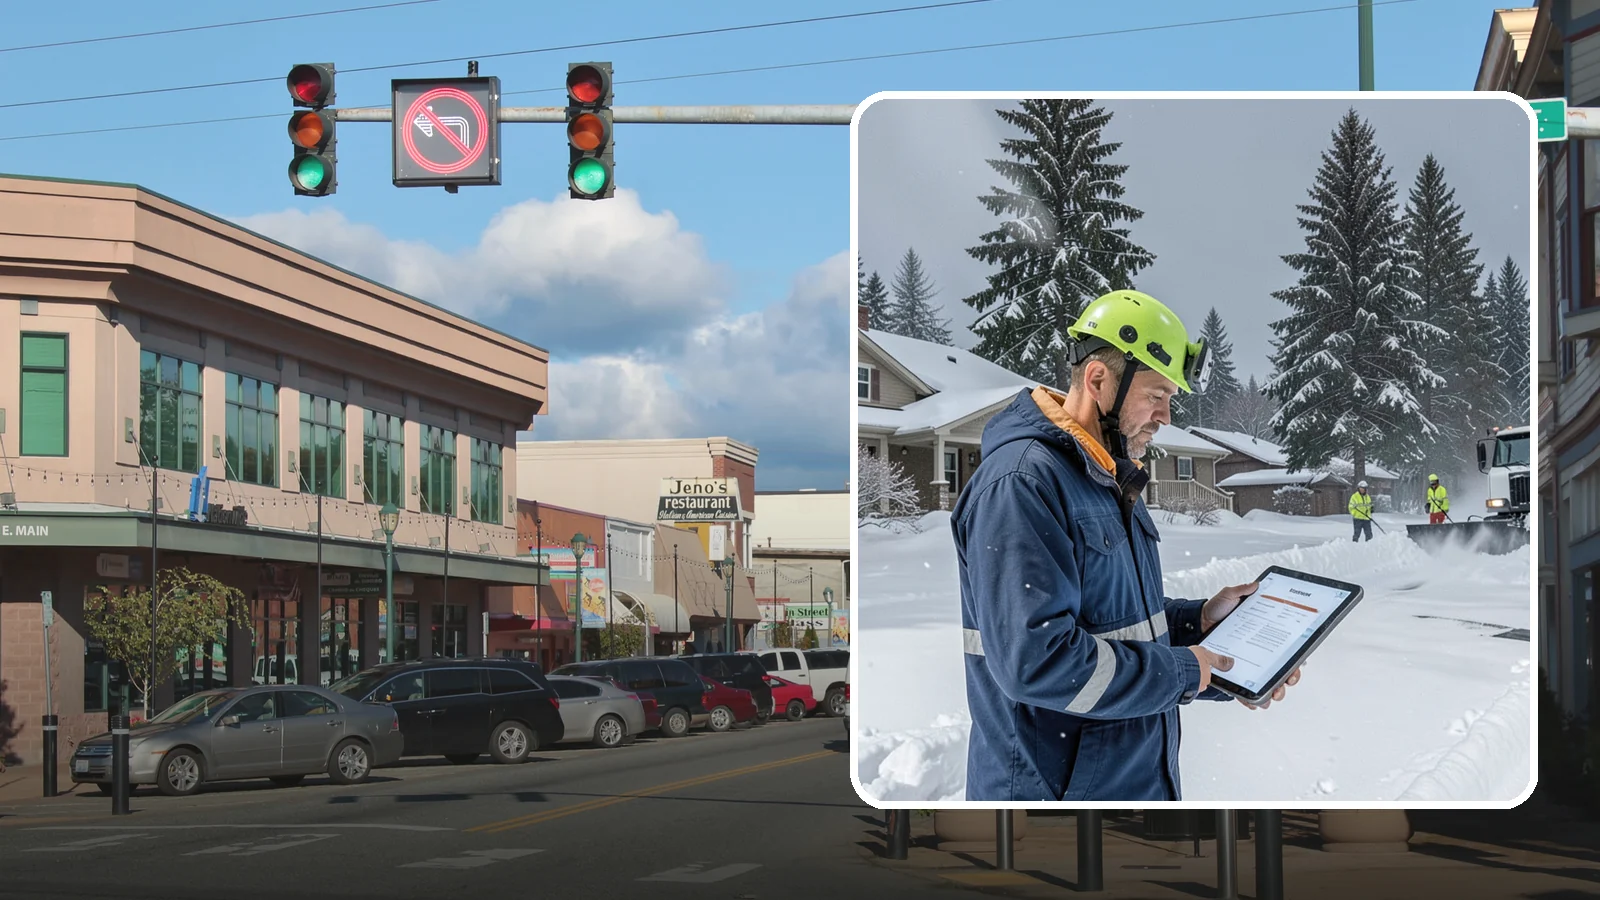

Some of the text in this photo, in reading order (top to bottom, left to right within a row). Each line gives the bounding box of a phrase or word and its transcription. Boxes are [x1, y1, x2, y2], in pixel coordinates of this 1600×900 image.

[669, 479, 728, 495] Jeno's
[665, 496, 731, 509] restaurant
[658, 509, 682, 520] Italian
[686, 509, 715, 519] American
[714, 509, 738, 519] Cuisine
[2, 525, 49, 536] E. MAIN
[785, 607, 829, 617] in Street
[791, 619, 824, 627] lass
